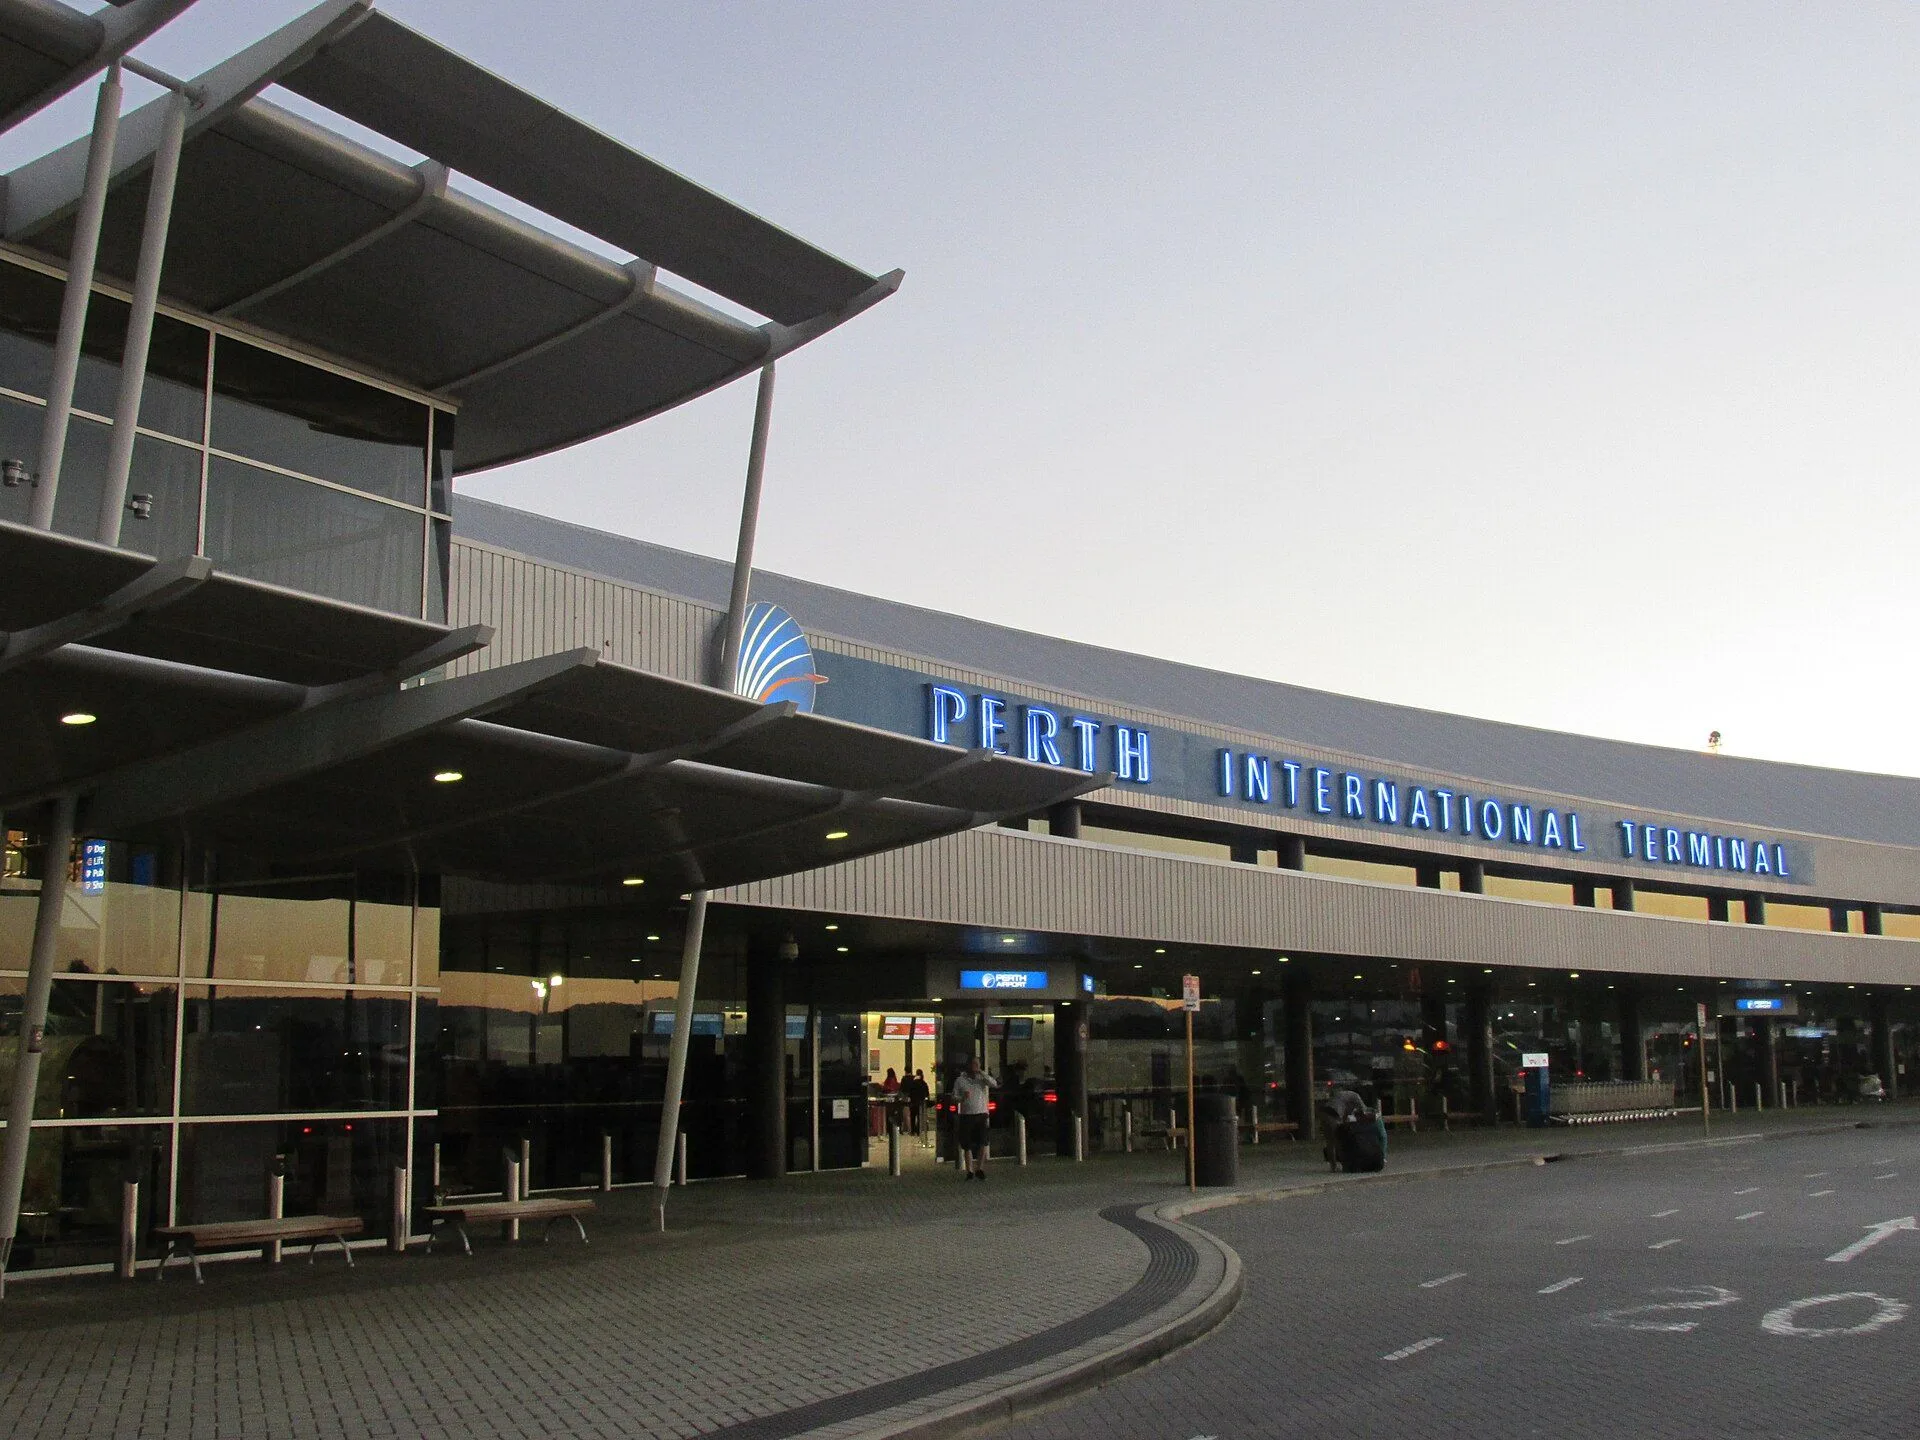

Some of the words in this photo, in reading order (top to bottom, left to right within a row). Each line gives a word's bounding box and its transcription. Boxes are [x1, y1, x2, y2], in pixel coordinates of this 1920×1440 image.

[927, 684, 1151, 783] PERTH
[1219, 747, 1586, 851] INTERNATIONAL
[1617, 819, 1790, 877] TERMINAL
[995, 974, 1027, 982] PERTH
[1591, 1285, 1911, 1337] 20
